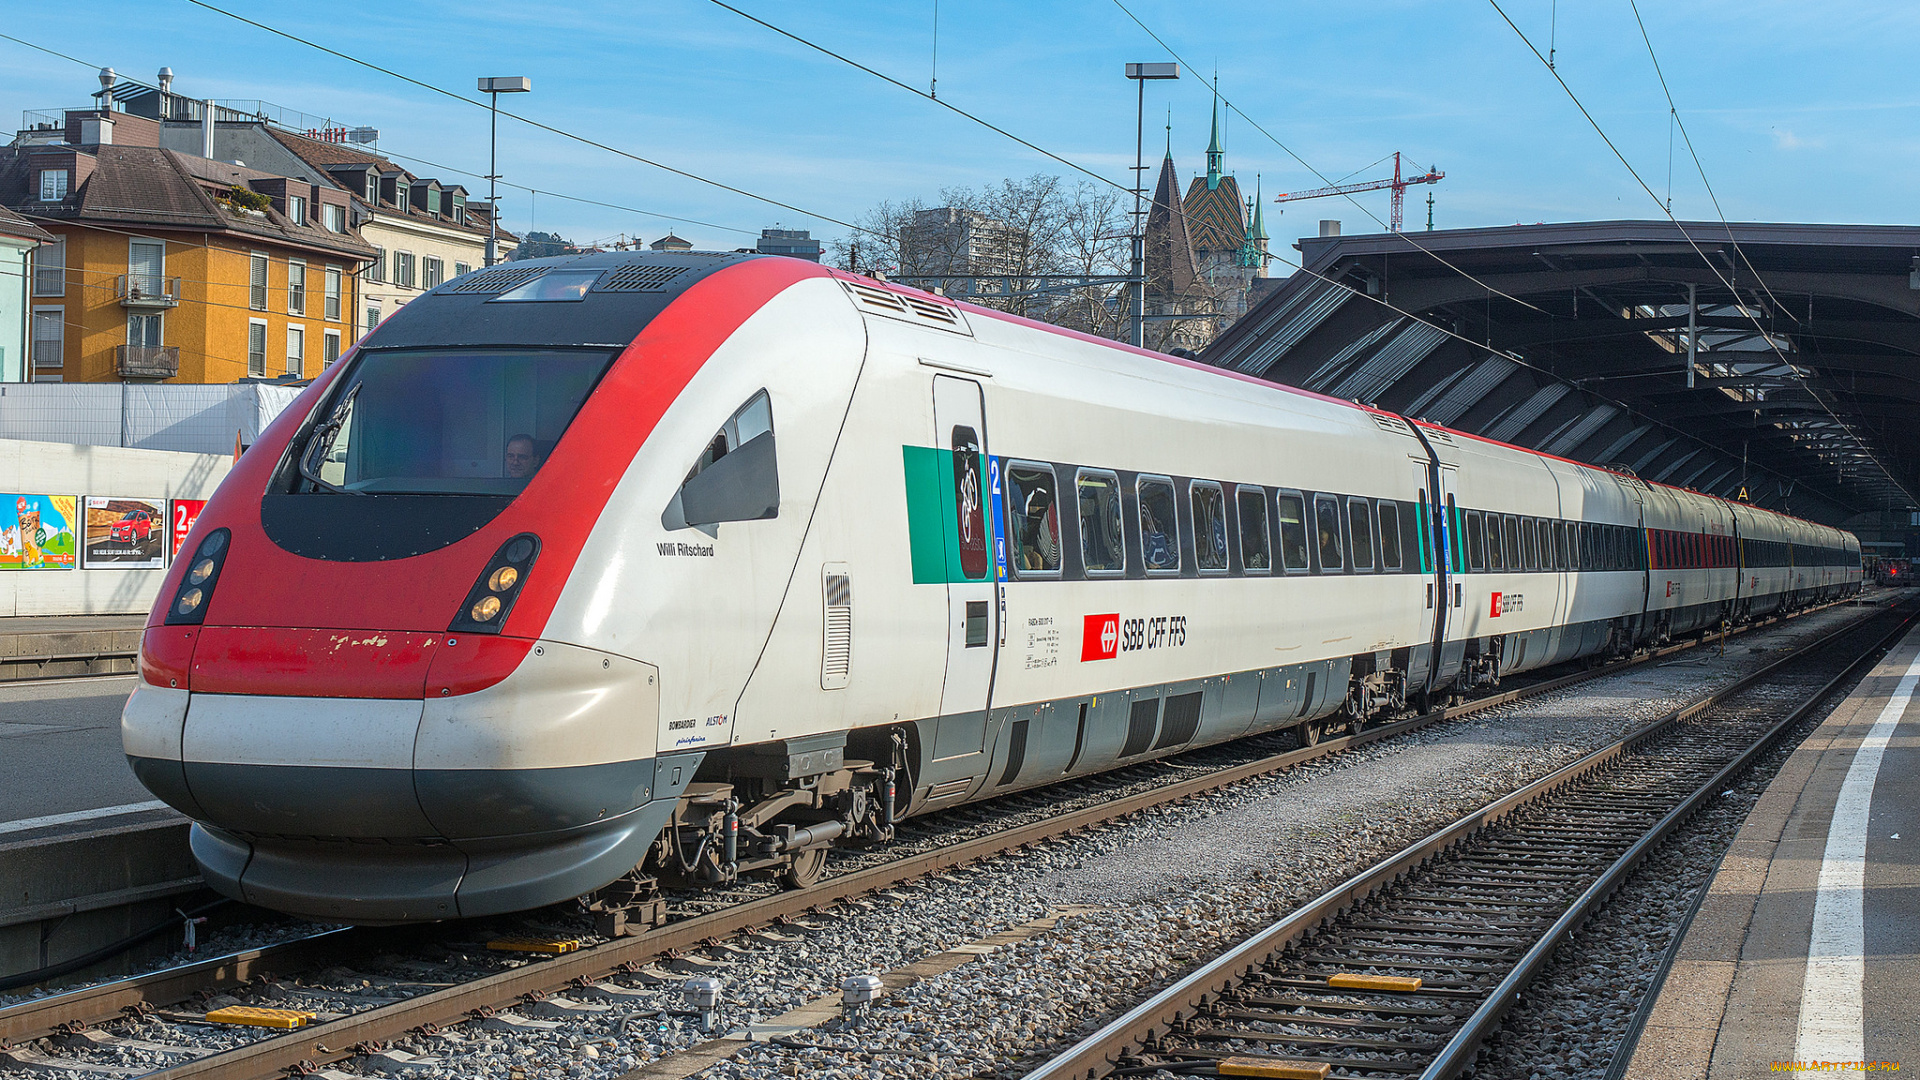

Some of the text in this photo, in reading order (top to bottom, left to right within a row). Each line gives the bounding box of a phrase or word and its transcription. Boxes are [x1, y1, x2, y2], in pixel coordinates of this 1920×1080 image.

[991, 460, 1001, 495] 2
[1737, 486, 1749, 501] A
[176, 504, 188, 531] 2
[656, 542, 714, 557] Willi Ritschard
[1122, 615, 1187, 652] SBB CFF FFS
[668, 713, 728, 731] BOMBARDIER ALSTOM
[675, 735, 706, 747] pininfarina
